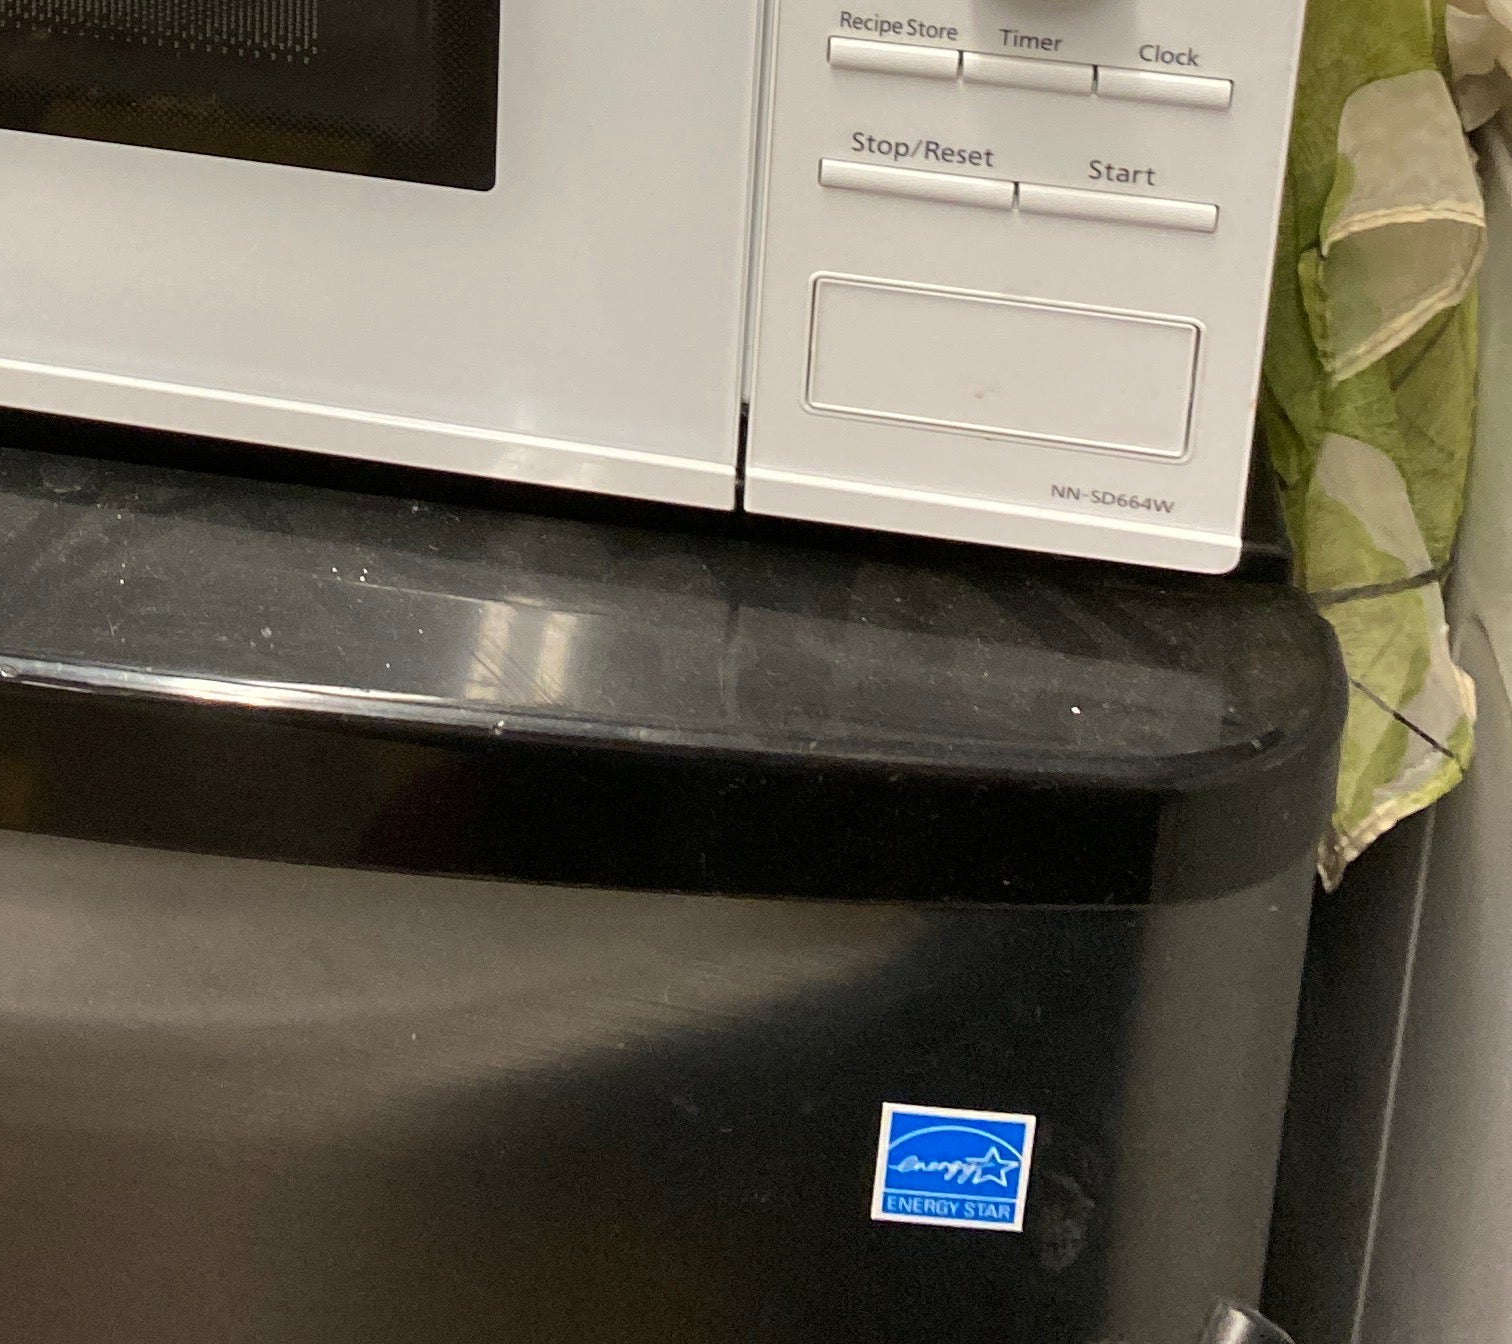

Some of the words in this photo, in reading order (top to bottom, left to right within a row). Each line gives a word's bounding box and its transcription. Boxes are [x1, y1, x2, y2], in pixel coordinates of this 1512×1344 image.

[839, 11, 904, 38] Recipe
[906, 18, 959, 41] Store
[999, 28, 1063, 53] Timer
[1138, 43, 1200, 68] Clock
[851, 131, 995, 168] Stop/Reset
[1089, 160, 1156, 188] Start
[1051, 484, 1175, 514] NN-SD664W
[887, 1195, 960, 1217] ENERGY
[963, 1202, 1011, 1220] STAR
